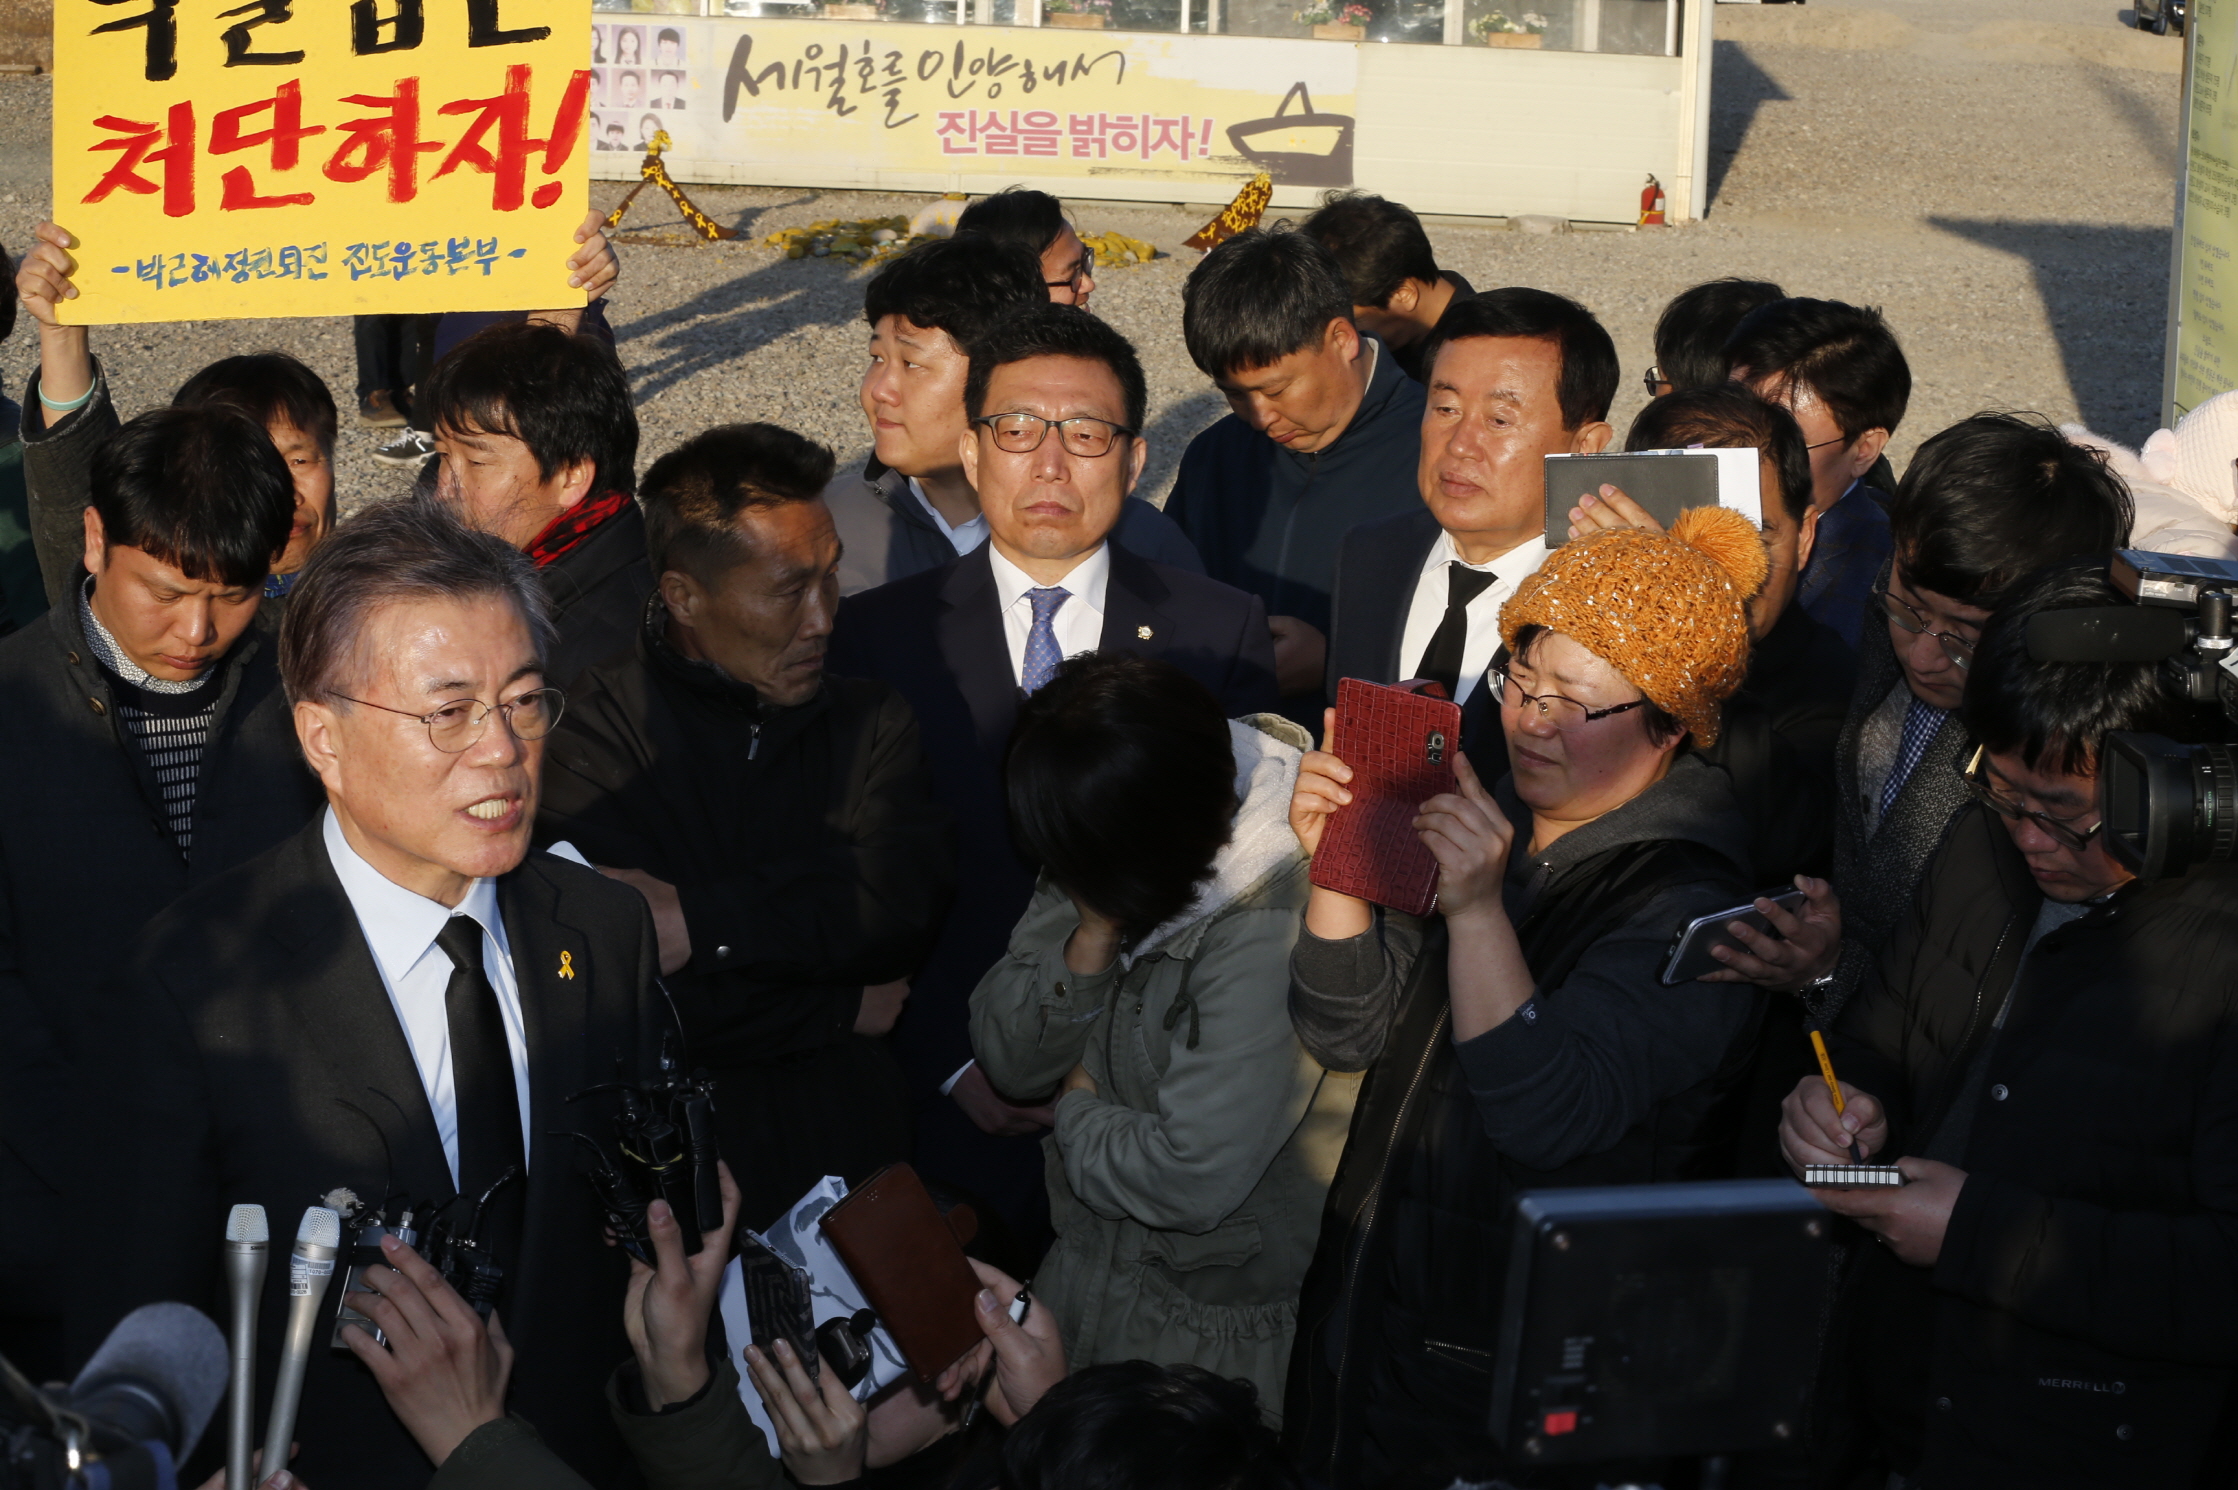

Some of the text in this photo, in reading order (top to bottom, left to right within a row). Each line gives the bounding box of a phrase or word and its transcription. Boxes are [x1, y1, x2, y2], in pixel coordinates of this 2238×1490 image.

[722, 33, 1126, 130] 세월호를 인양해서
[80, 62, 592, 218] 처단하자!
[936, 109, 1215, 162] 진실을 밝히자!
[2037, 1377, 2111, 1393] MERRELL
